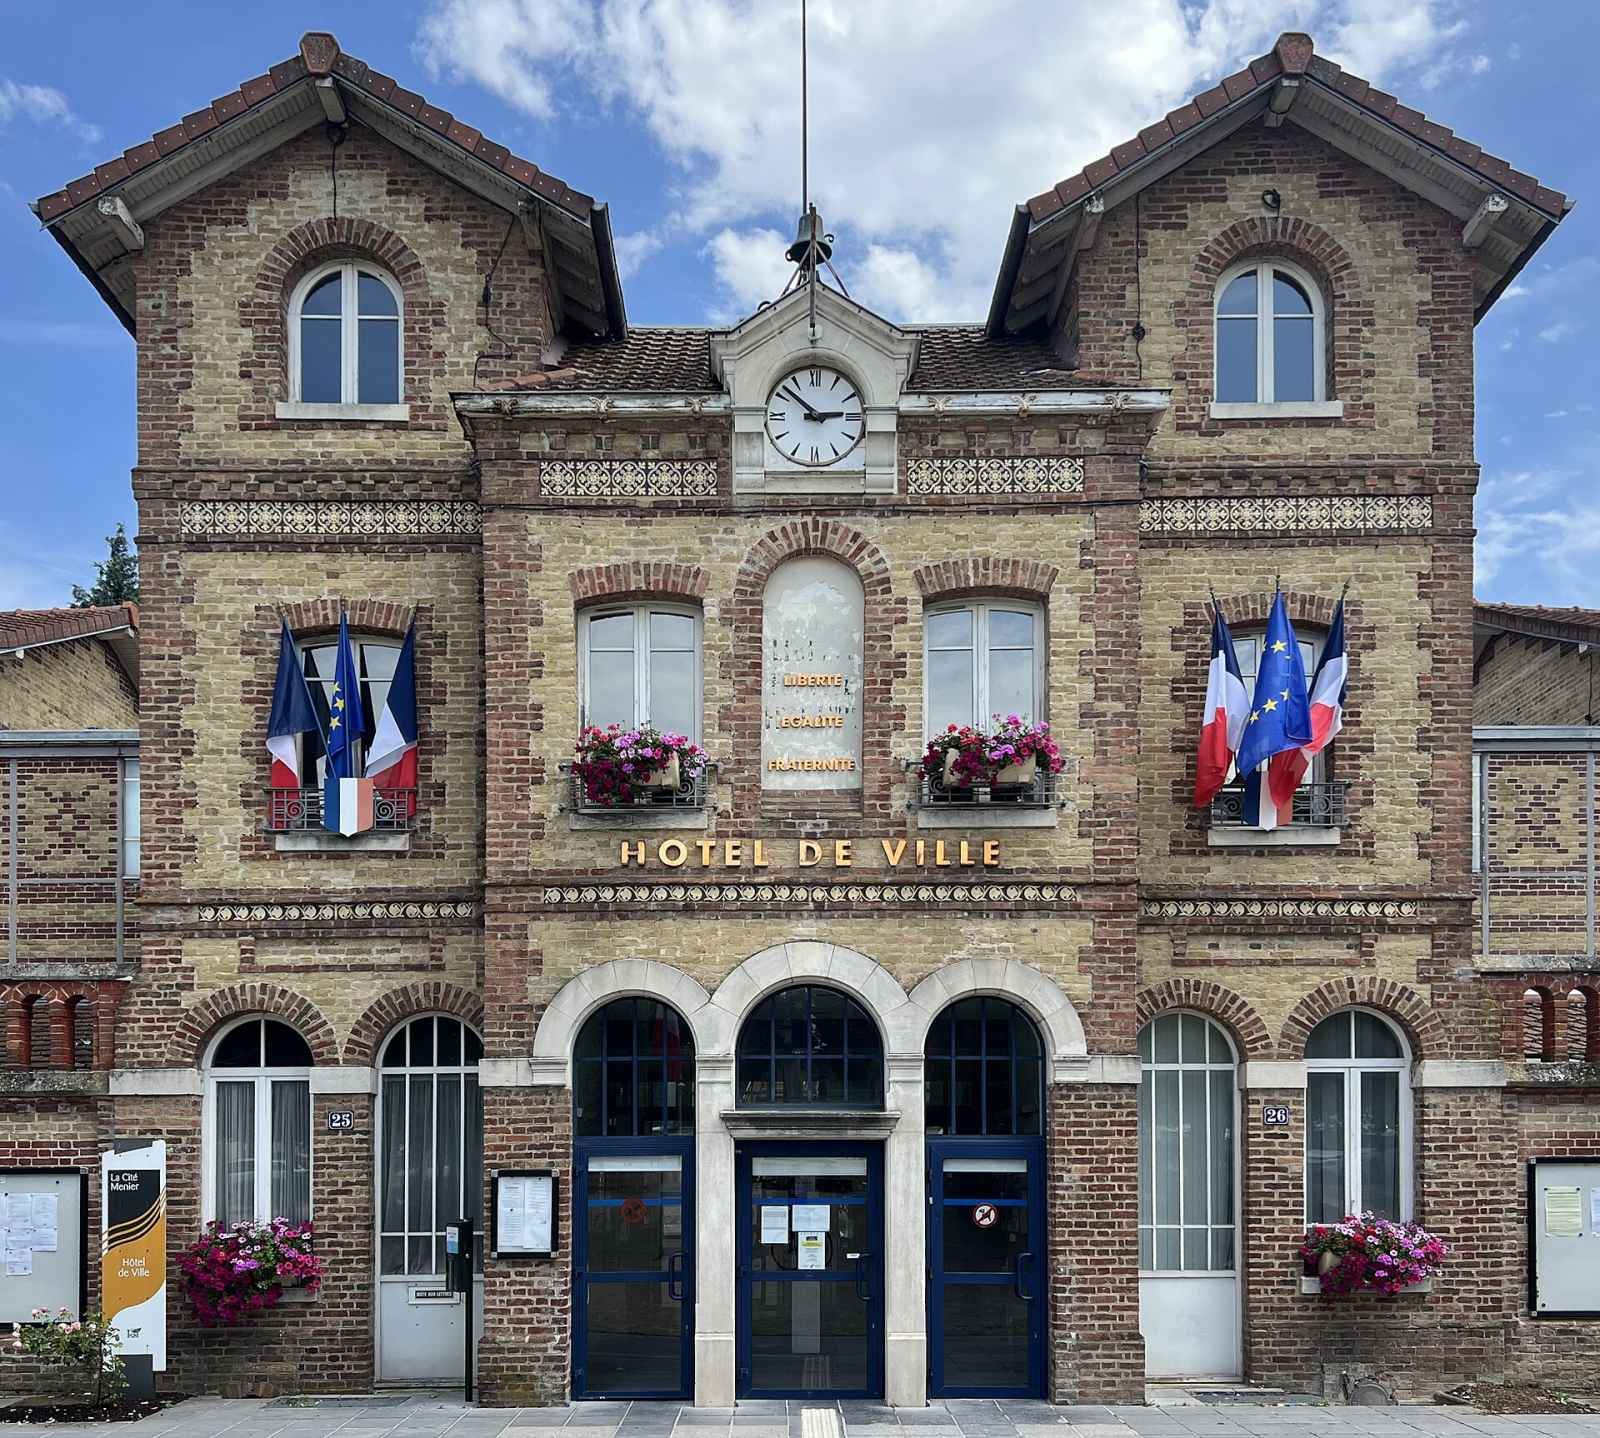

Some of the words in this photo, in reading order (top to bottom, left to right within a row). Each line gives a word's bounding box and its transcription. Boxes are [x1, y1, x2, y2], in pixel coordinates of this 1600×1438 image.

[809, 369, 822, 387] XII
[620, 839, 769, 867] HOTEL
[799, 839, 852, 867] DE
[881, 839, 1001, 867] VILLE
[331, 1113, 351, 1127] 25
[1266, 1109, 1286, 1123] 26
[110, 1173, 120, 1182] La
[121, 1172, 139, 1182] Cité
[110, 1182, 140, 1192] Menier
[122, 1256, 146, 1267] Hôtel
[118, 1267, 129, 1277] de
[131, 1267, 150, 1277] Ville
